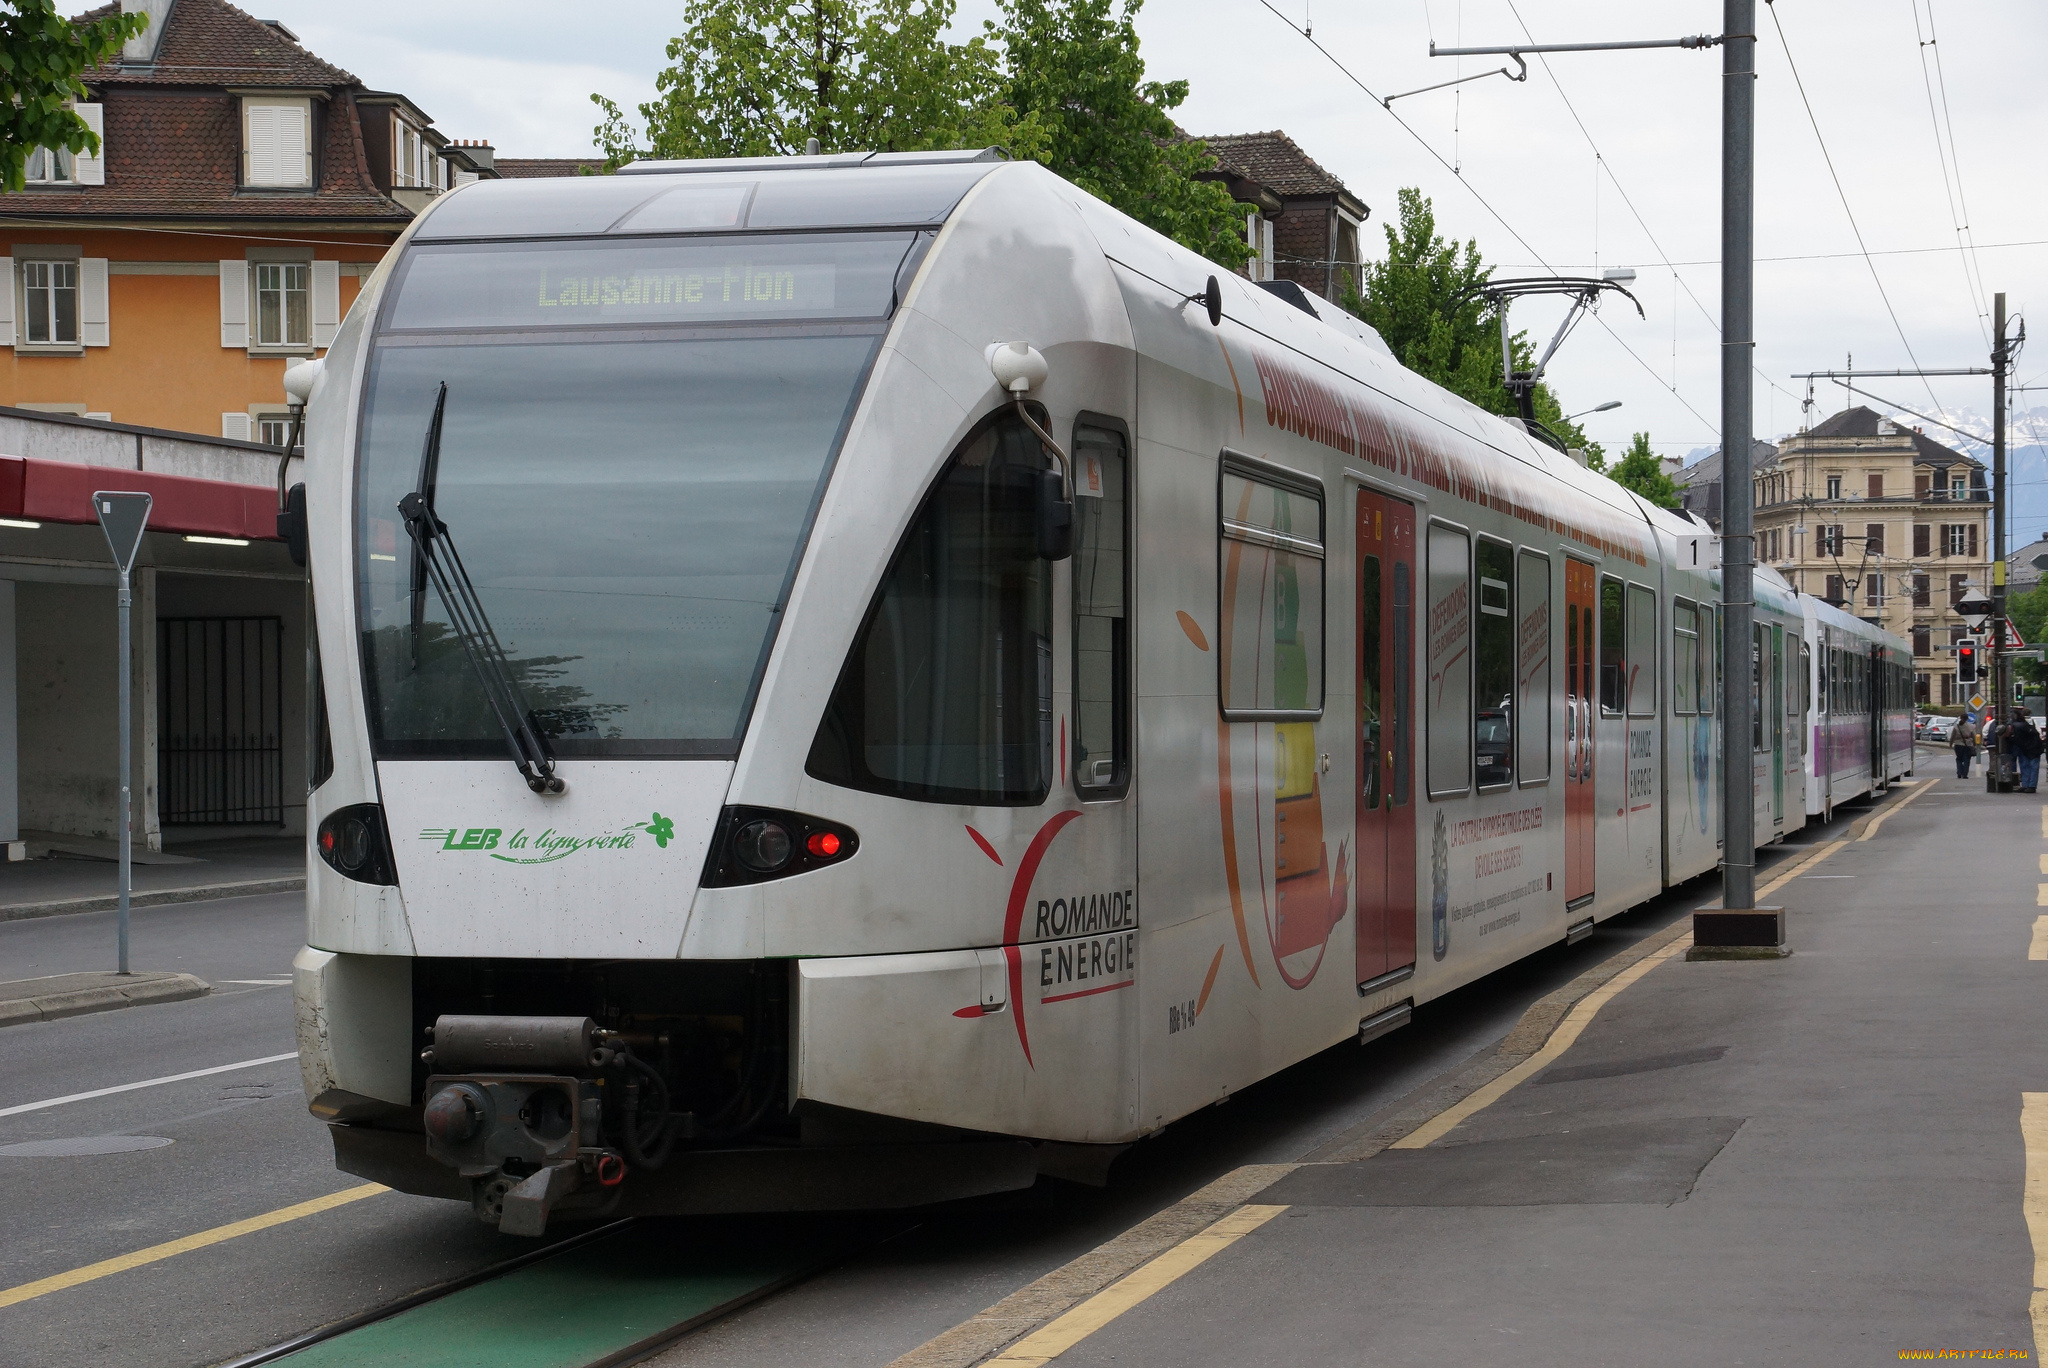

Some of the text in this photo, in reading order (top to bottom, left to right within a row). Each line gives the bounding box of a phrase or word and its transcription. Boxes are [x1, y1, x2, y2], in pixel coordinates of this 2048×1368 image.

[1690, 539, 1697, 566] 1
[1630, 730, 1651, 759] ROMANDE
[1630, 768, 1651, 798] ENERGIE
[443, 828, 636, 857] LEB la ligne verte
[1036, 889, 1132, 938] ROMANDE
[1041, 934, 1134, 986] ENERGIE
